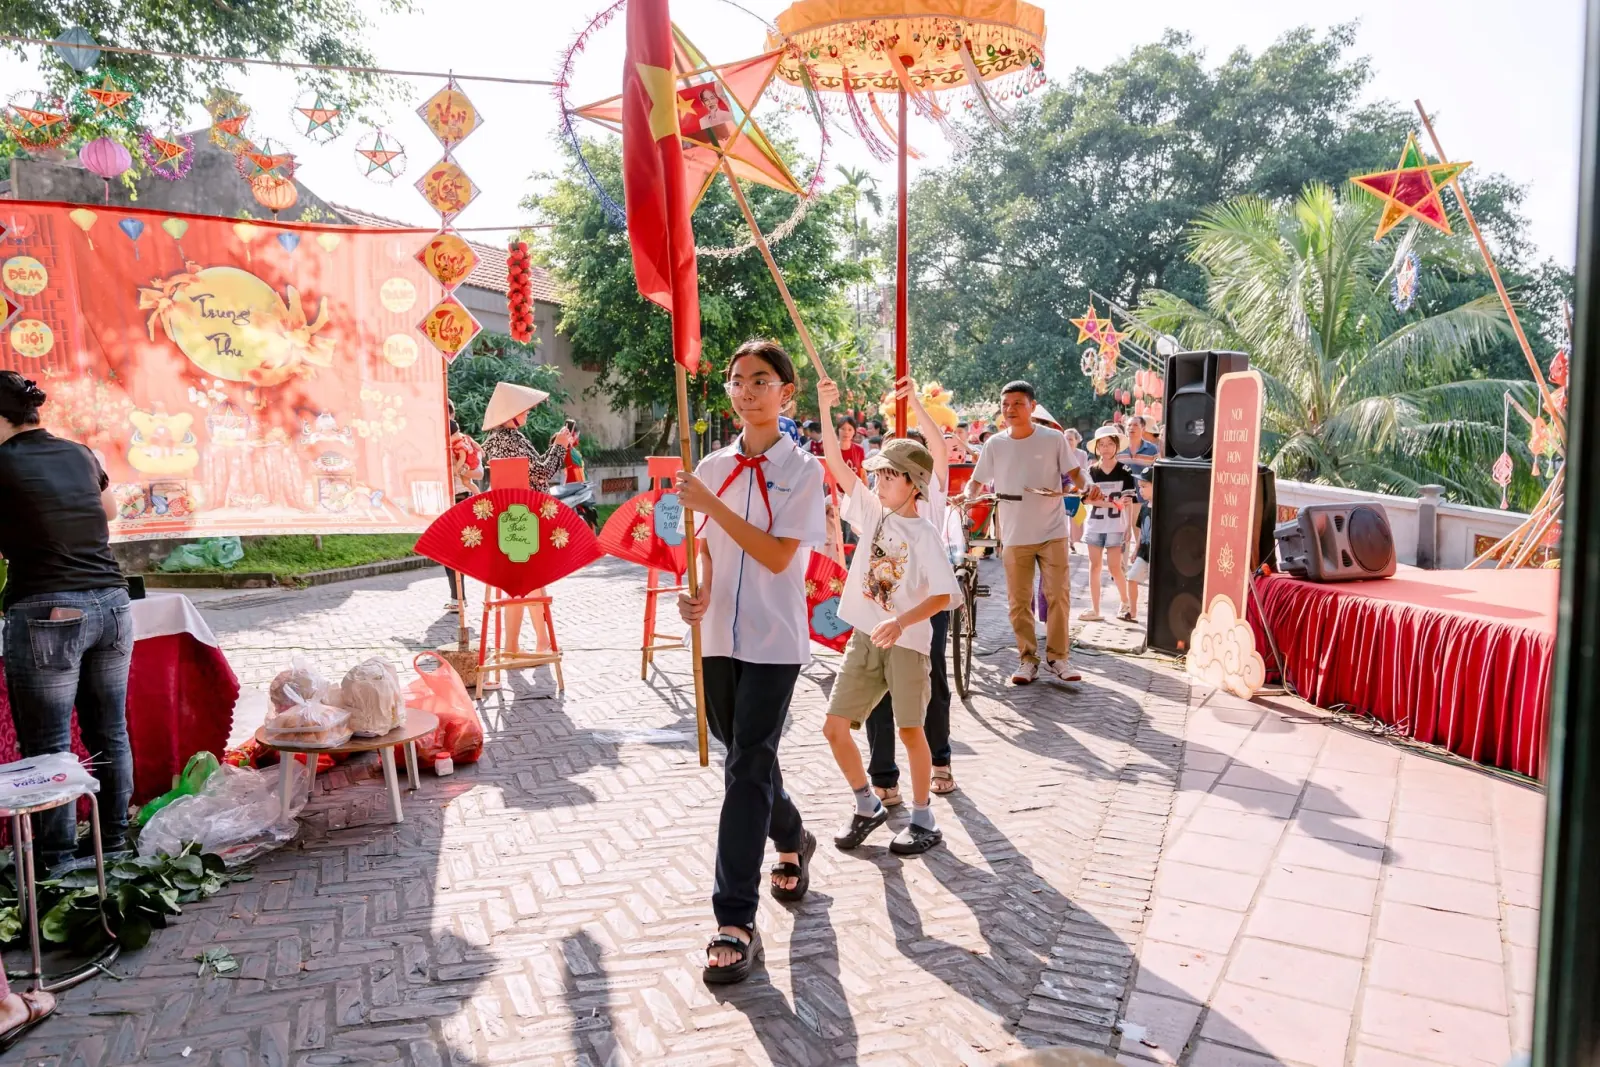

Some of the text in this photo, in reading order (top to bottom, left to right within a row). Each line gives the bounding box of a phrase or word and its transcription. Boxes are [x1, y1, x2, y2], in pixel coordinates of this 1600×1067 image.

[8, 268, 43, 282] ĐÊM
[189, 293, 251, 326] Trung
[205, 332, 244, 358] Thu
[657, 503, 680, 514] Trung
[663, 521, 677, 529] 202
